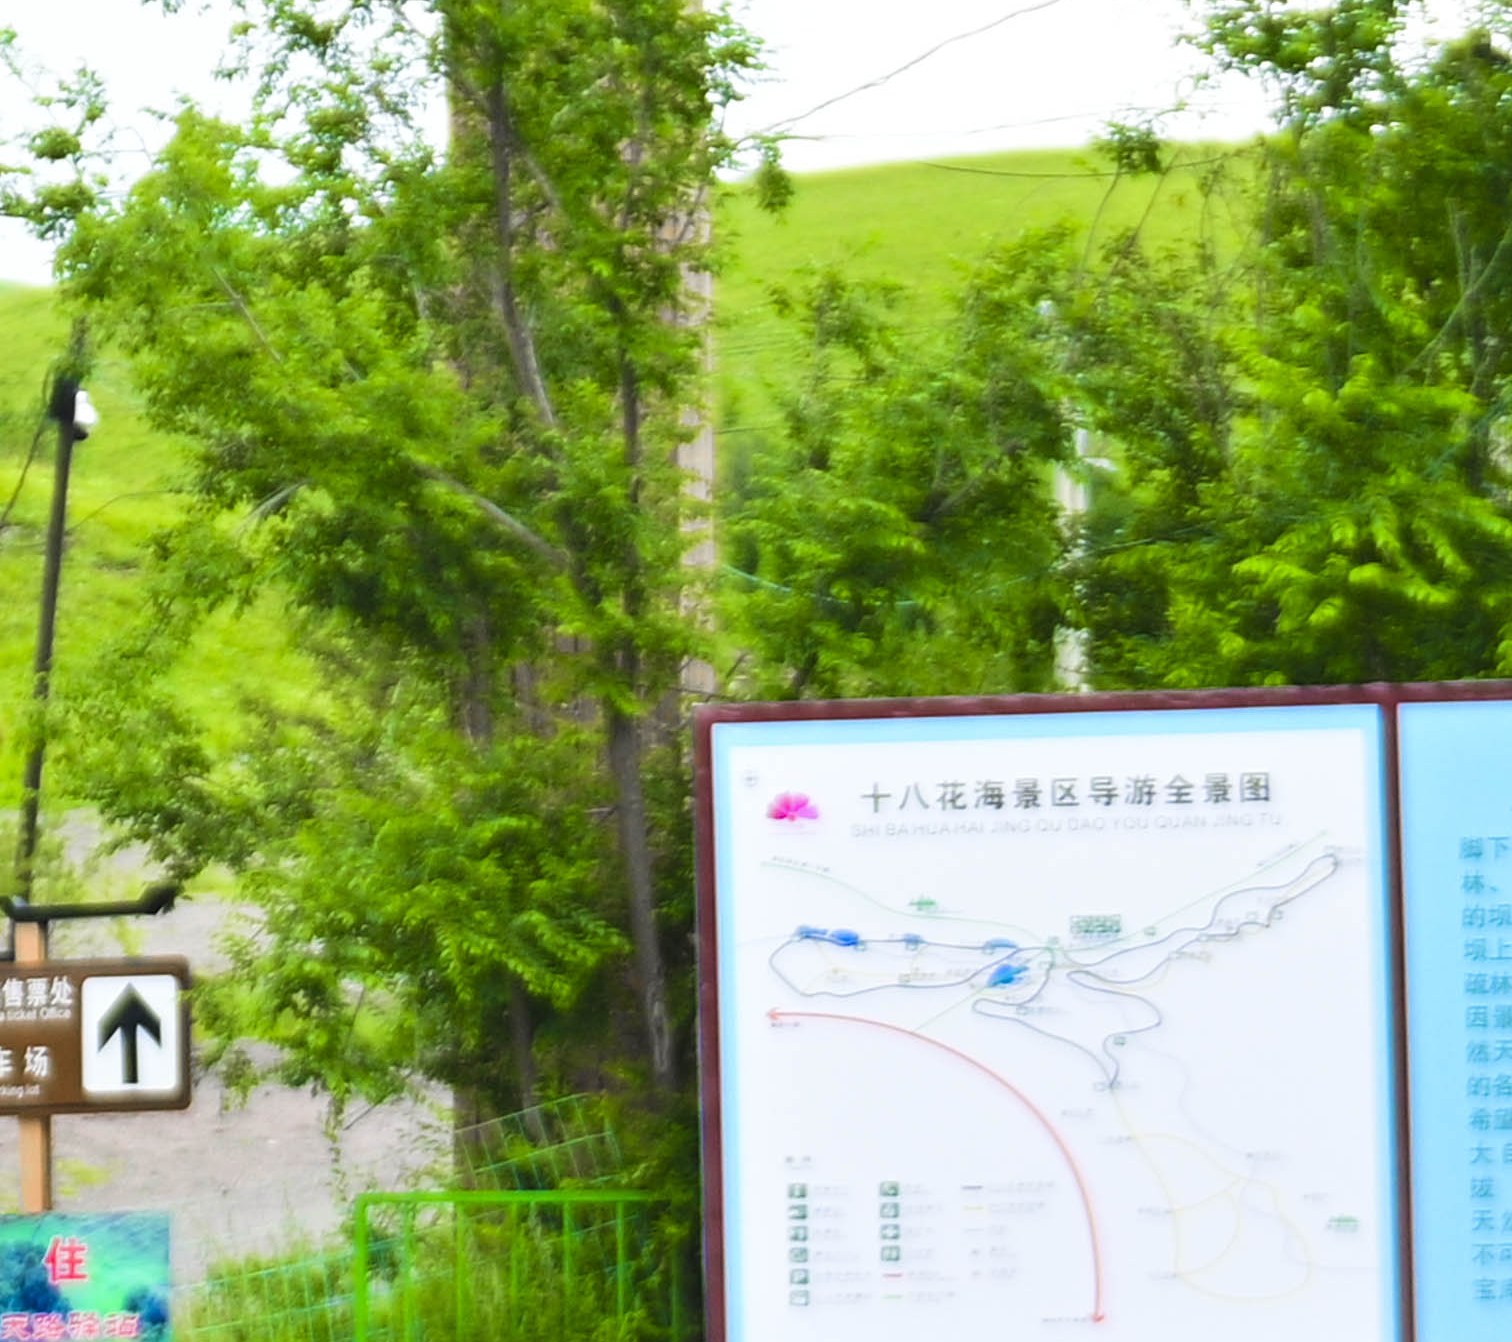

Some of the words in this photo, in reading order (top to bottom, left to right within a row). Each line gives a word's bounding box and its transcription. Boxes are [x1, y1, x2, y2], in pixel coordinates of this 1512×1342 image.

[860, 772, 1271, 813] 十八花海景区导游全景图
[43, 1235, 89, 1284] 住
